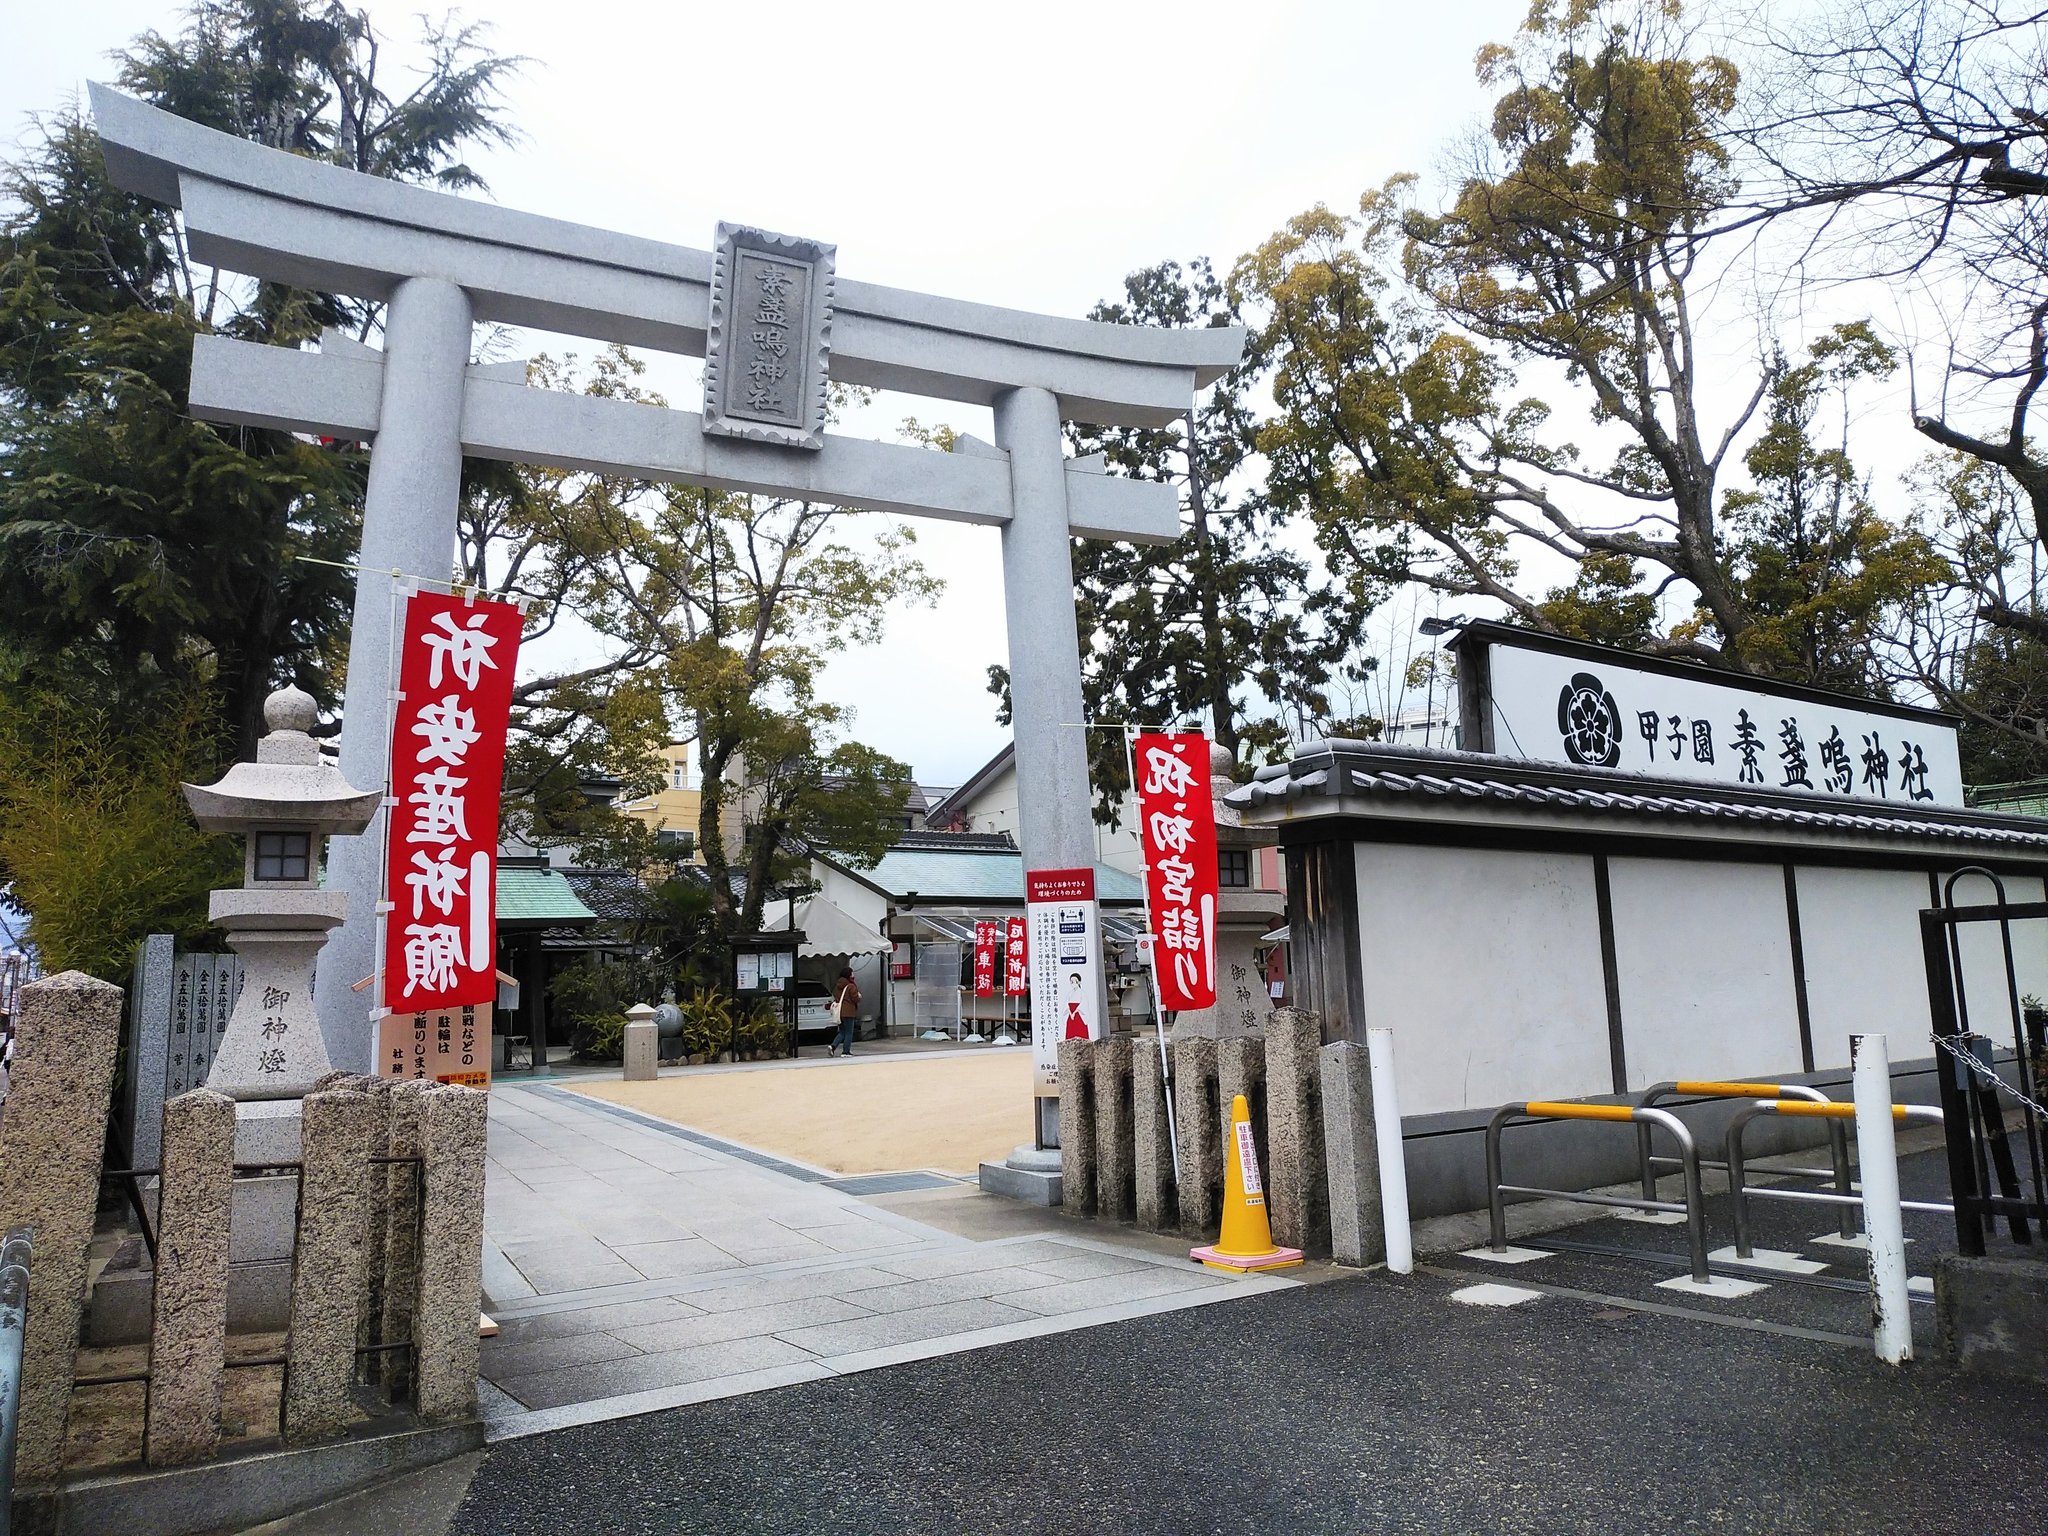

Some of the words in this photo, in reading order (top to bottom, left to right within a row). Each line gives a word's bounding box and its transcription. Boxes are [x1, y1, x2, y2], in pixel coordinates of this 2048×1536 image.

[1636, 708, 1716, 766] 甲子園
[1231, 963, 1258, 1029] 御神燈
[258, 986, 290, 1074] 御神燈
